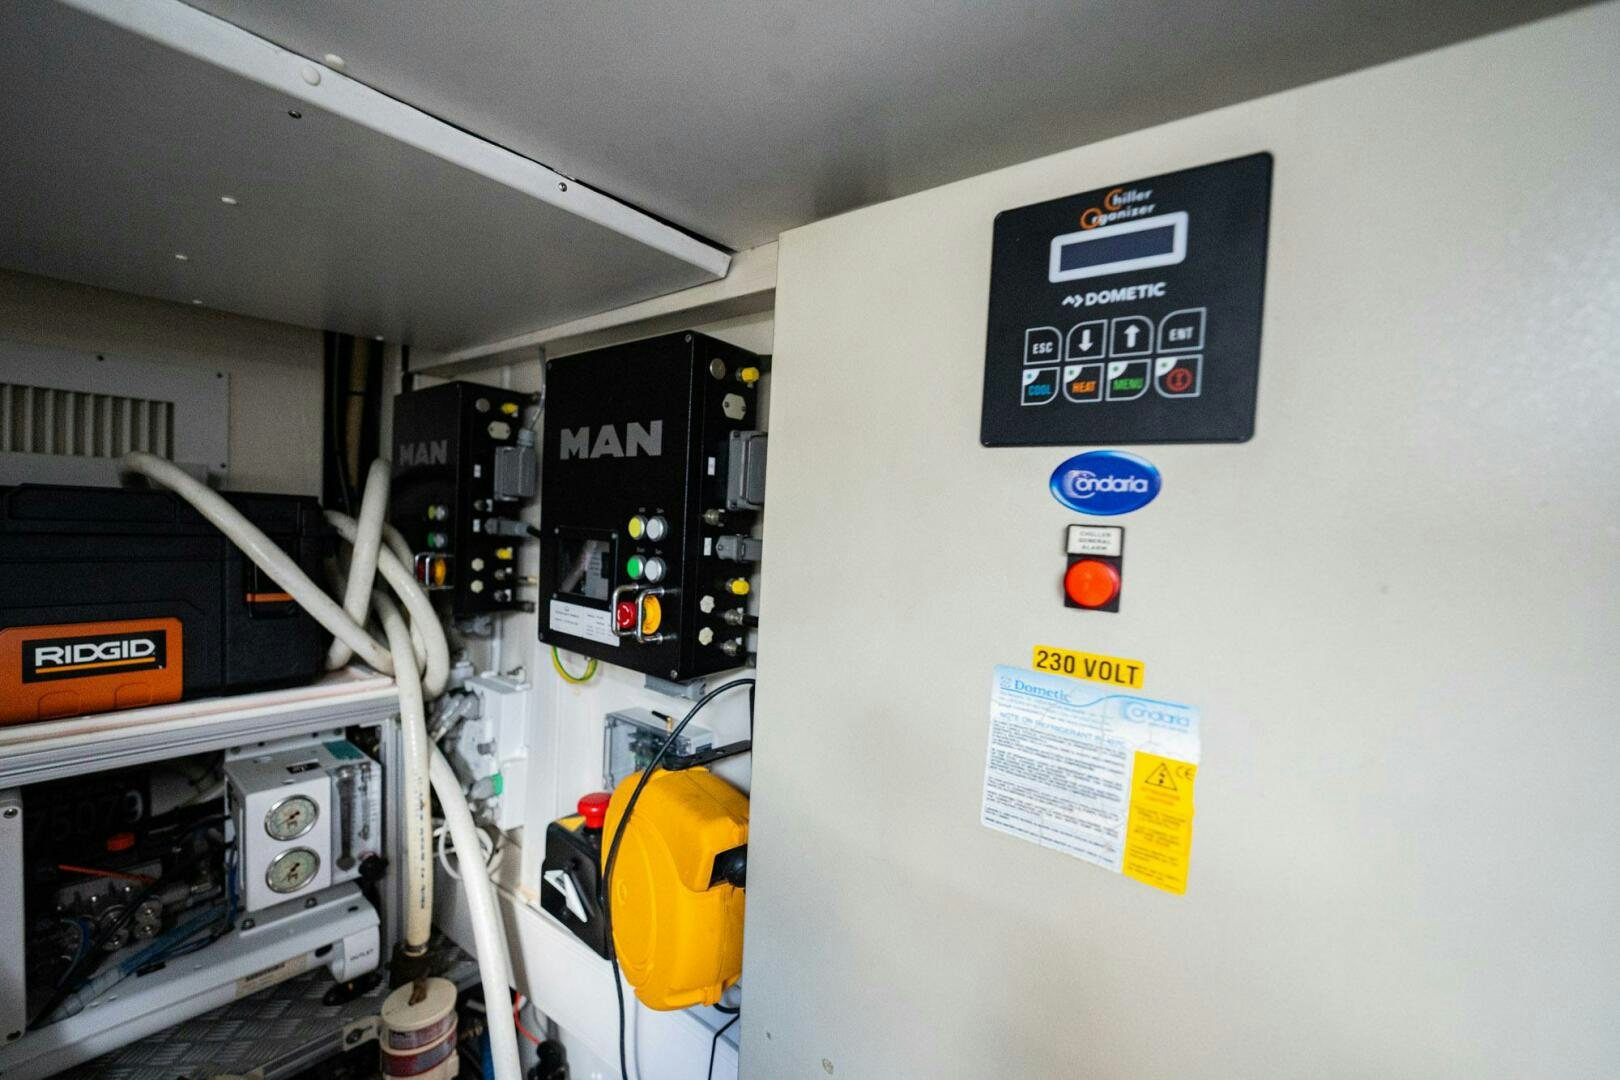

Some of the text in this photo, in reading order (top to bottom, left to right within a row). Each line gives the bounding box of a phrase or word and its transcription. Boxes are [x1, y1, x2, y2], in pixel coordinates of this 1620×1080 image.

[1104, 188, 1153, 212] Chiller
[1085, 282, 1166, 306] DOMETIC
[1168, 326, 1193, 341] ENT
[1032, 342, 1053, 354] ESC
[1028, 384, 1051, 396] COOL
[1072, 380, 1096, 393] HEAT
[1113, 378, 1143, 390] MENU
[560, 420, 662, 460] MAN
[400, 439, 447, 466] MAN
[1063, 469, 1148, 499] Condaria
[35, 639, 156, 666] RIDGID
[1036, 650, 1139, 685] 230 VOLT
[1014, 679, 1070, 703] Dometic
